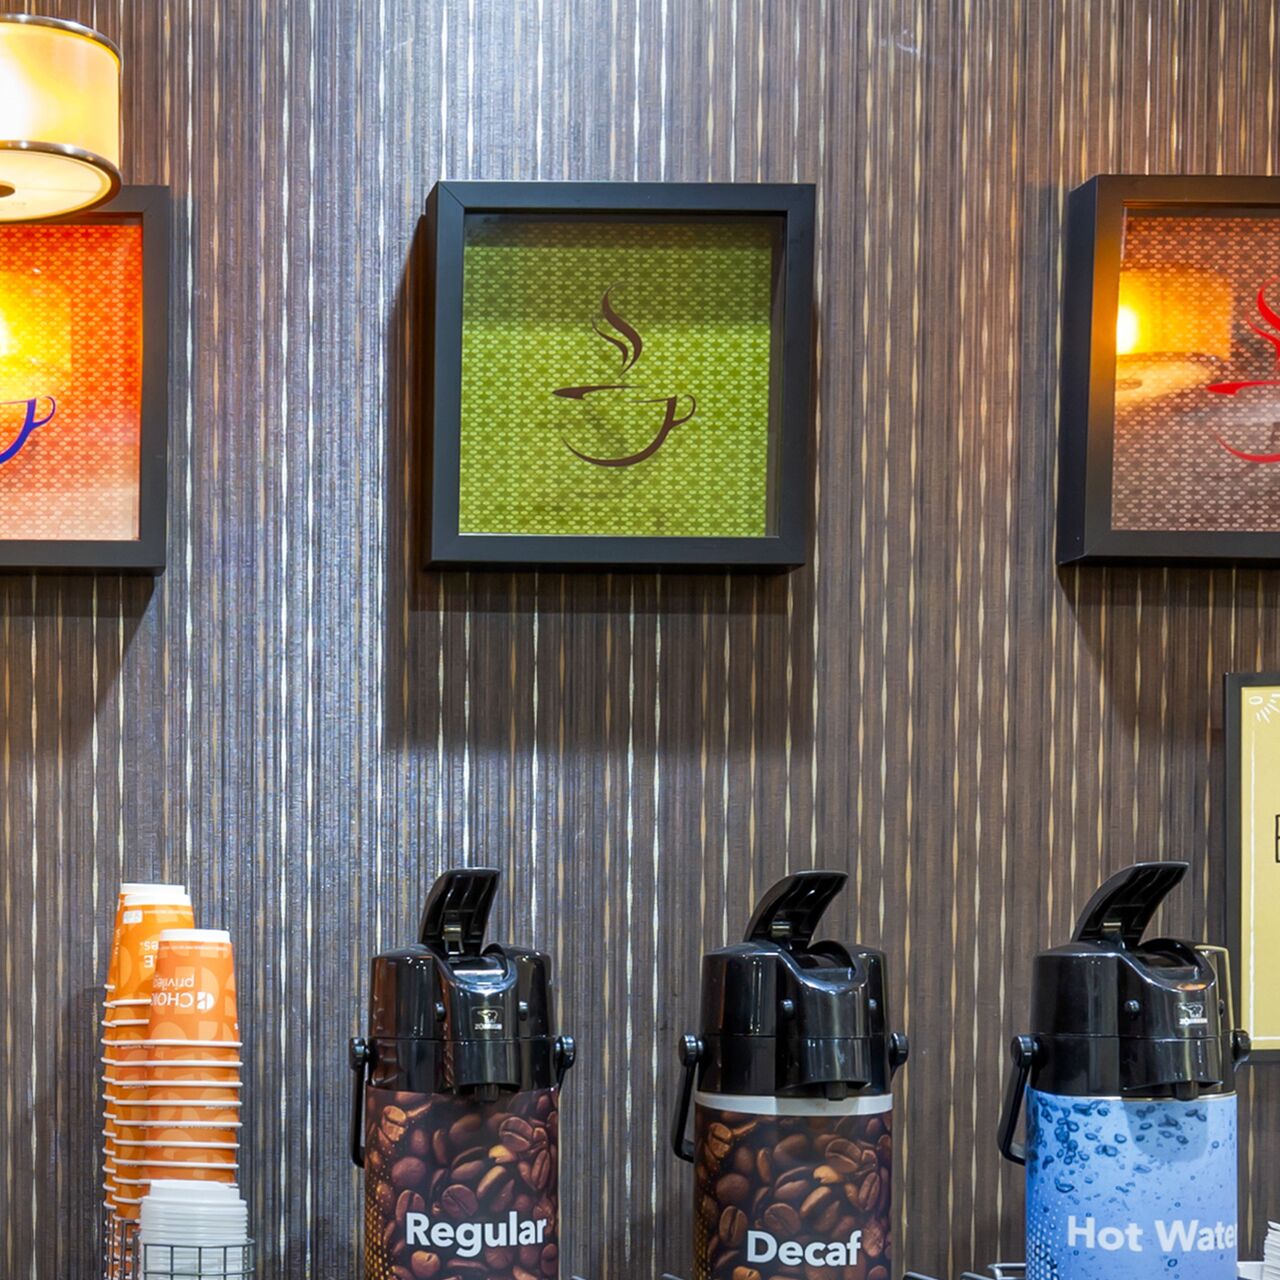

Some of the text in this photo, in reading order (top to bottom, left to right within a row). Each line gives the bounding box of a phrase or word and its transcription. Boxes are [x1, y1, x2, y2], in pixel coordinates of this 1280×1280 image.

[406, 1211, 547, 1257] Regular
[747, 1230, 862, 1266] Decaf
[1067, 1215, 1144, 1252] Hot
